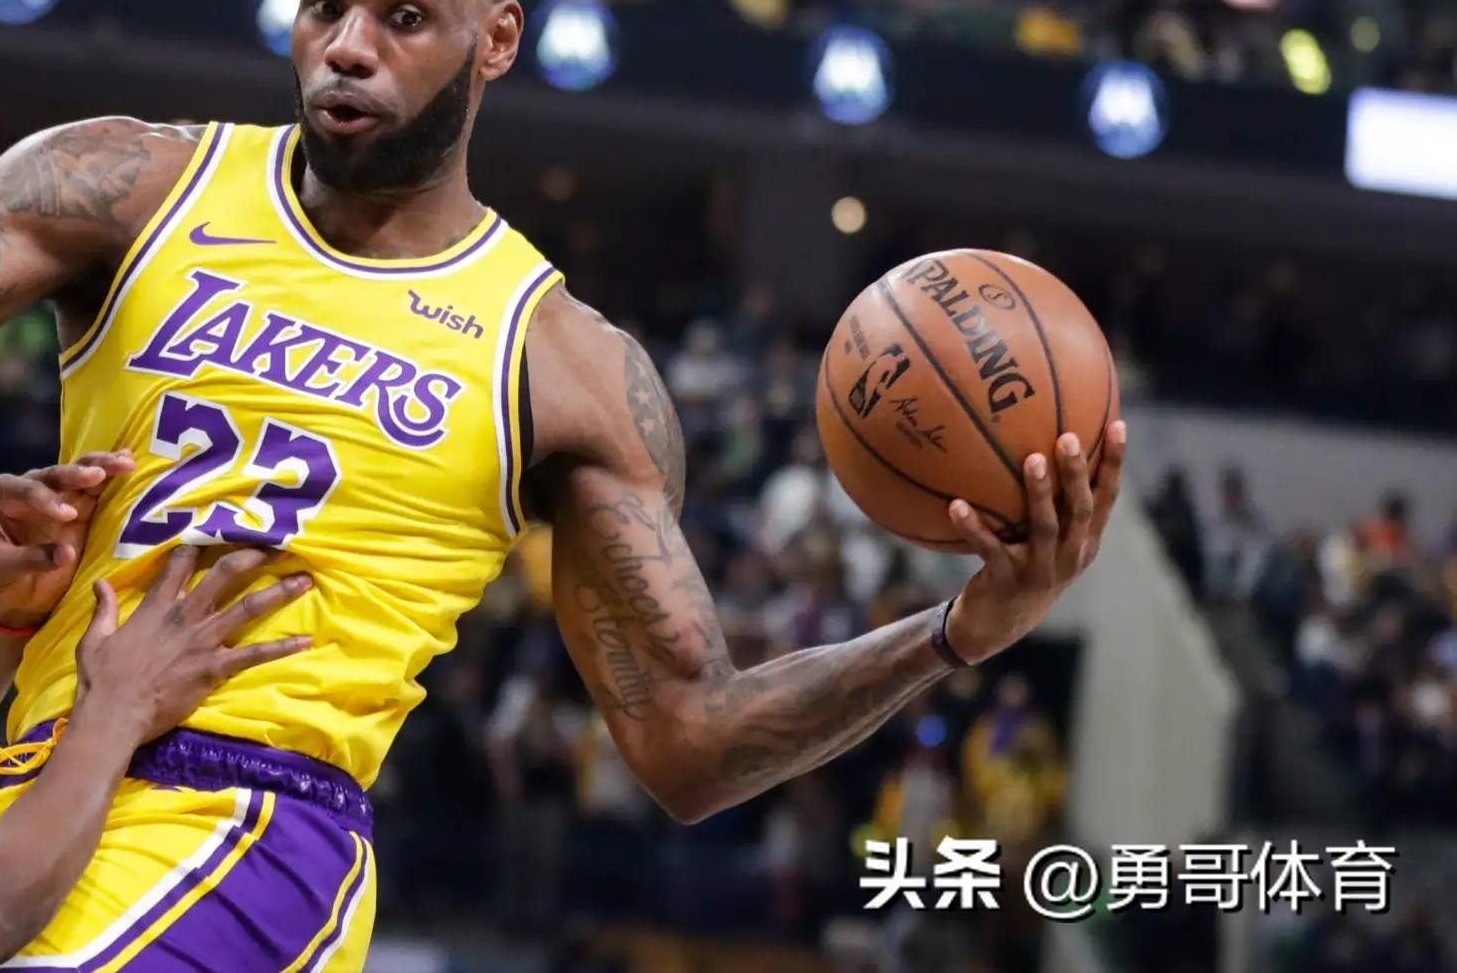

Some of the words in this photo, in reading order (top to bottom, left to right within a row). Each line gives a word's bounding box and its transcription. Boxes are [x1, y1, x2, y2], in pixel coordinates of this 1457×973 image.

[125, 269, 463, 451] LAKERS
[407, 289, 485, 339] wish
[113, 392, 342, 560] 23
